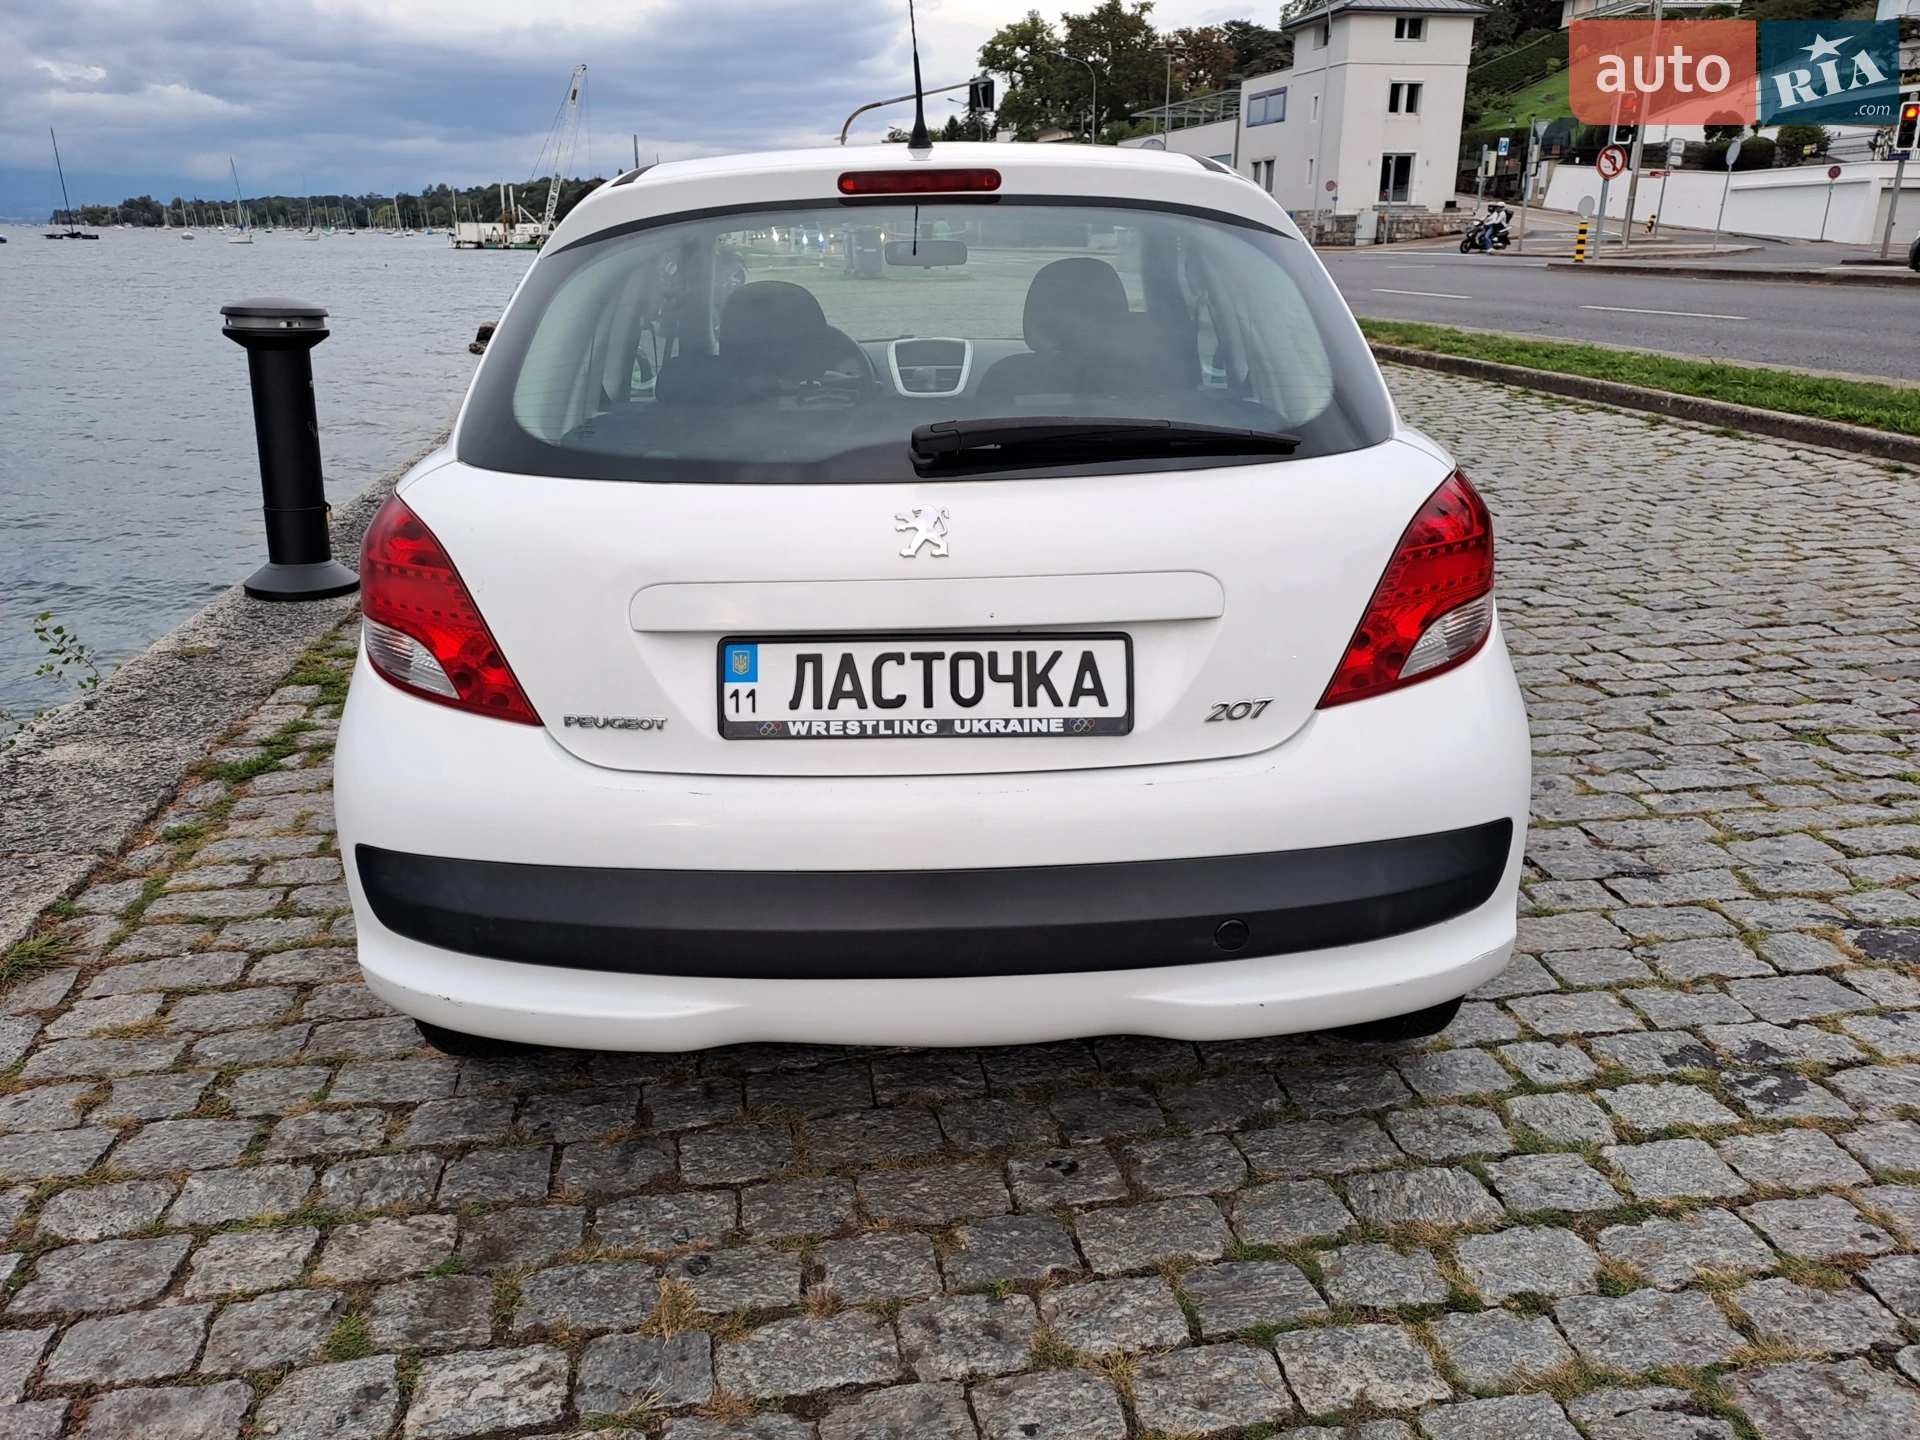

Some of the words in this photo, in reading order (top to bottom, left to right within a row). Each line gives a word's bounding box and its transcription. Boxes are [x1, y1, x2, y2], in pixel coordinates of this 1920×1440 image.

[789, 650, 1109, 710] ЛАСТОЧКА
[729, 688, 757, 714] 11
[1204, 696, 1275, 723] 207
[563, 713, 668, 730] PEUGEOT
[788, 719, 938, 736] WRESTLING
[954, 718, 1064, 734] UKRAINE
